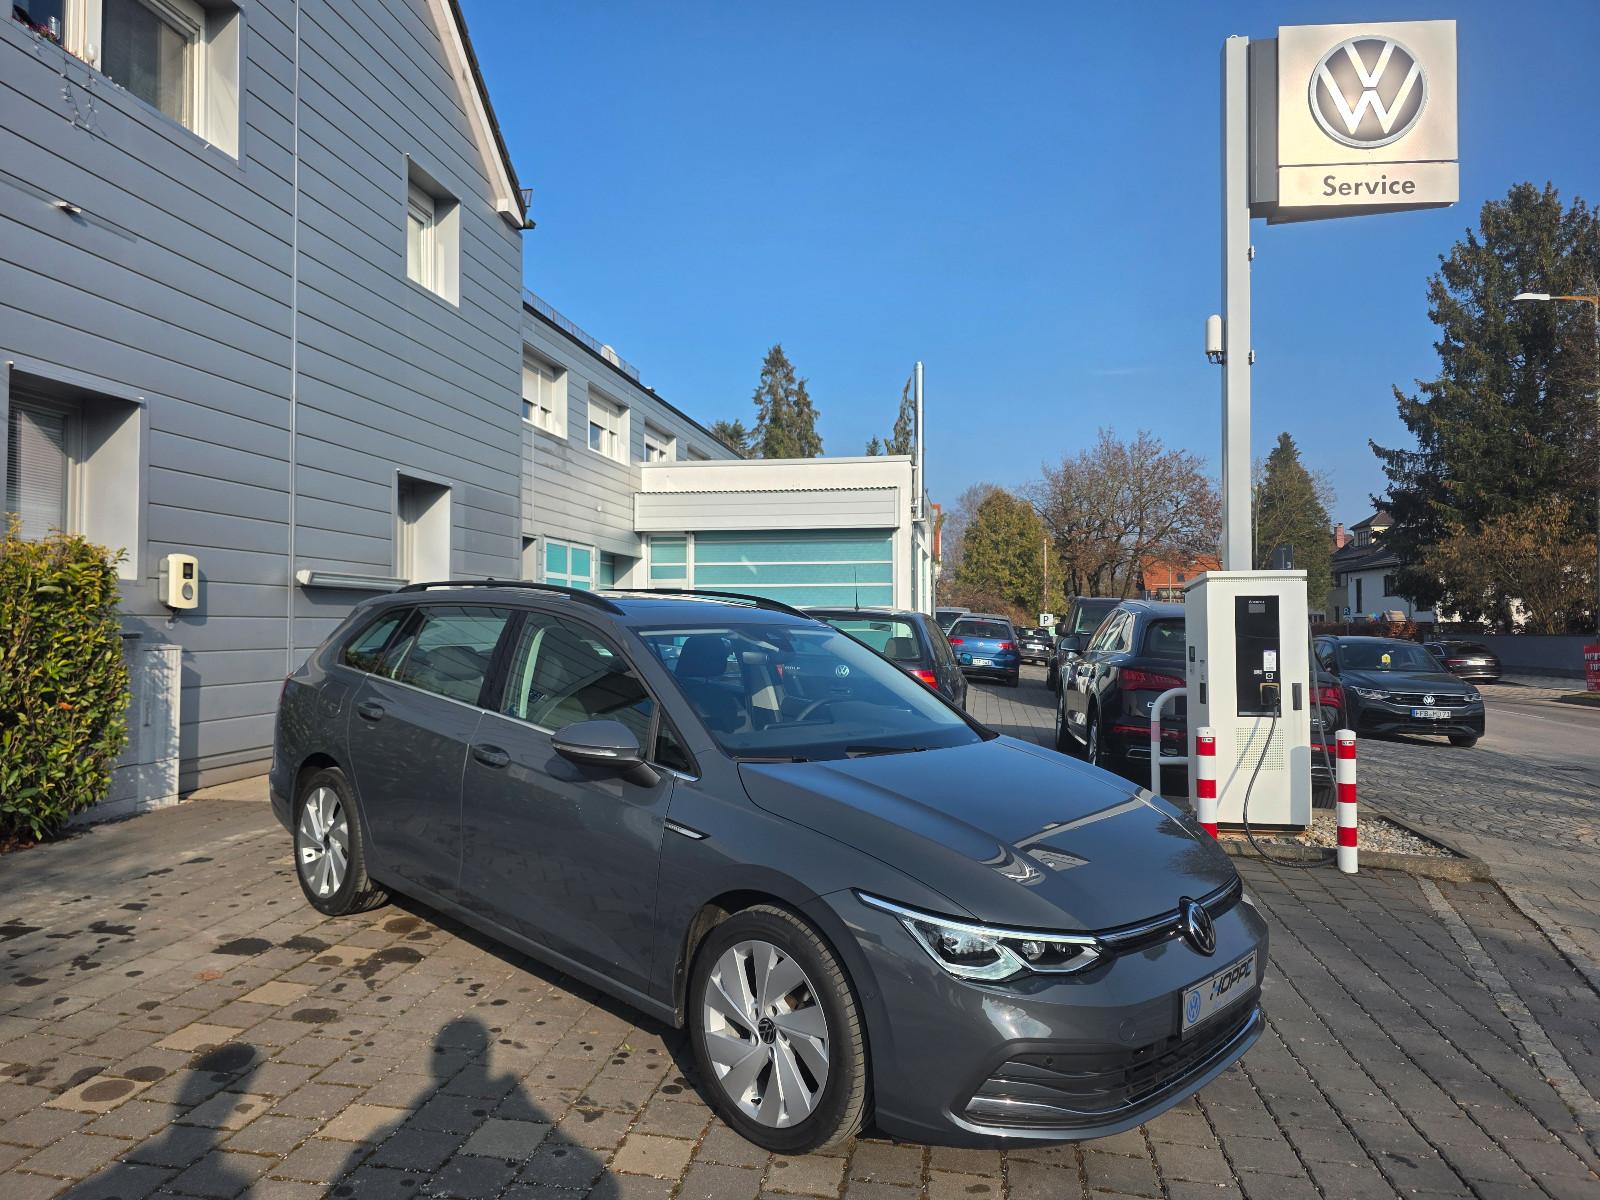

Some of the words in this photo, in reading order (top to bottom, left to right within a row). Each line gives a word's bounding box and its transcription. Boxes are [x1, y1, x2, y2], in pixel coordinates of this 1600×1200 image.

[1314, 38, 1424, 142] VW
[1322, 174, 1417, 197] Service
[1043, 615, 1049, 625] P
[1209, 957, 1254, 1000] HOPPE
[1186, 991, 1201, 1024] VW
